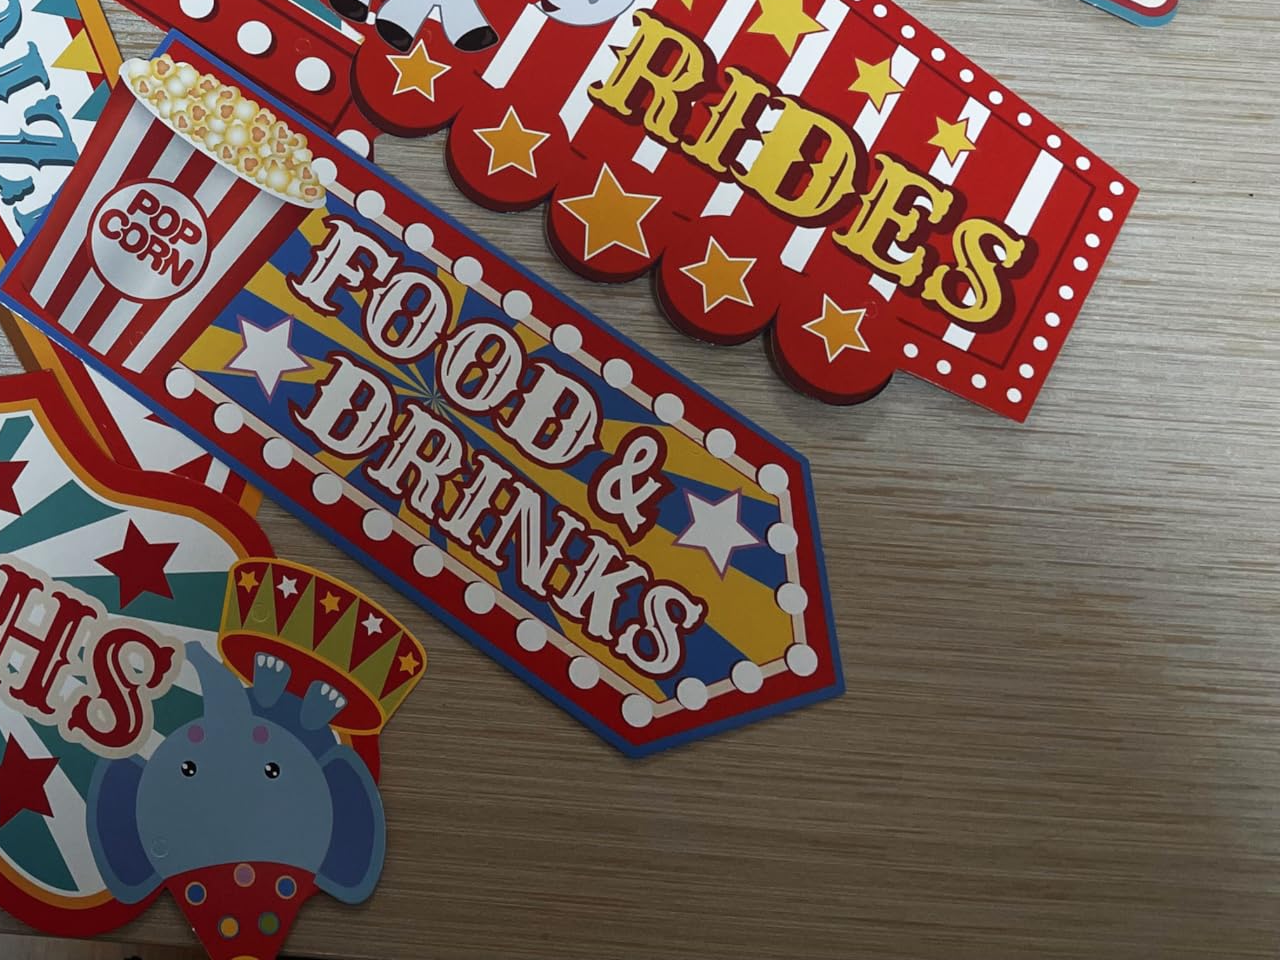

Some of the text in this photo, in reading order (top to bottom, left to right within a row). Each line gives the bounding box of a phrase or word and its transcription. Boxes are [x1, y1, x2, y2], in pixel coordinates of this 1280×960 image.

[98, 208, 194, 287] CORN
[126, 188, 202, 245] POP
[586, 9, 1027, 325] RIDES
[295, 356, 704, 673] DRINKS
[296, 218, 664, 534] FOOD &
